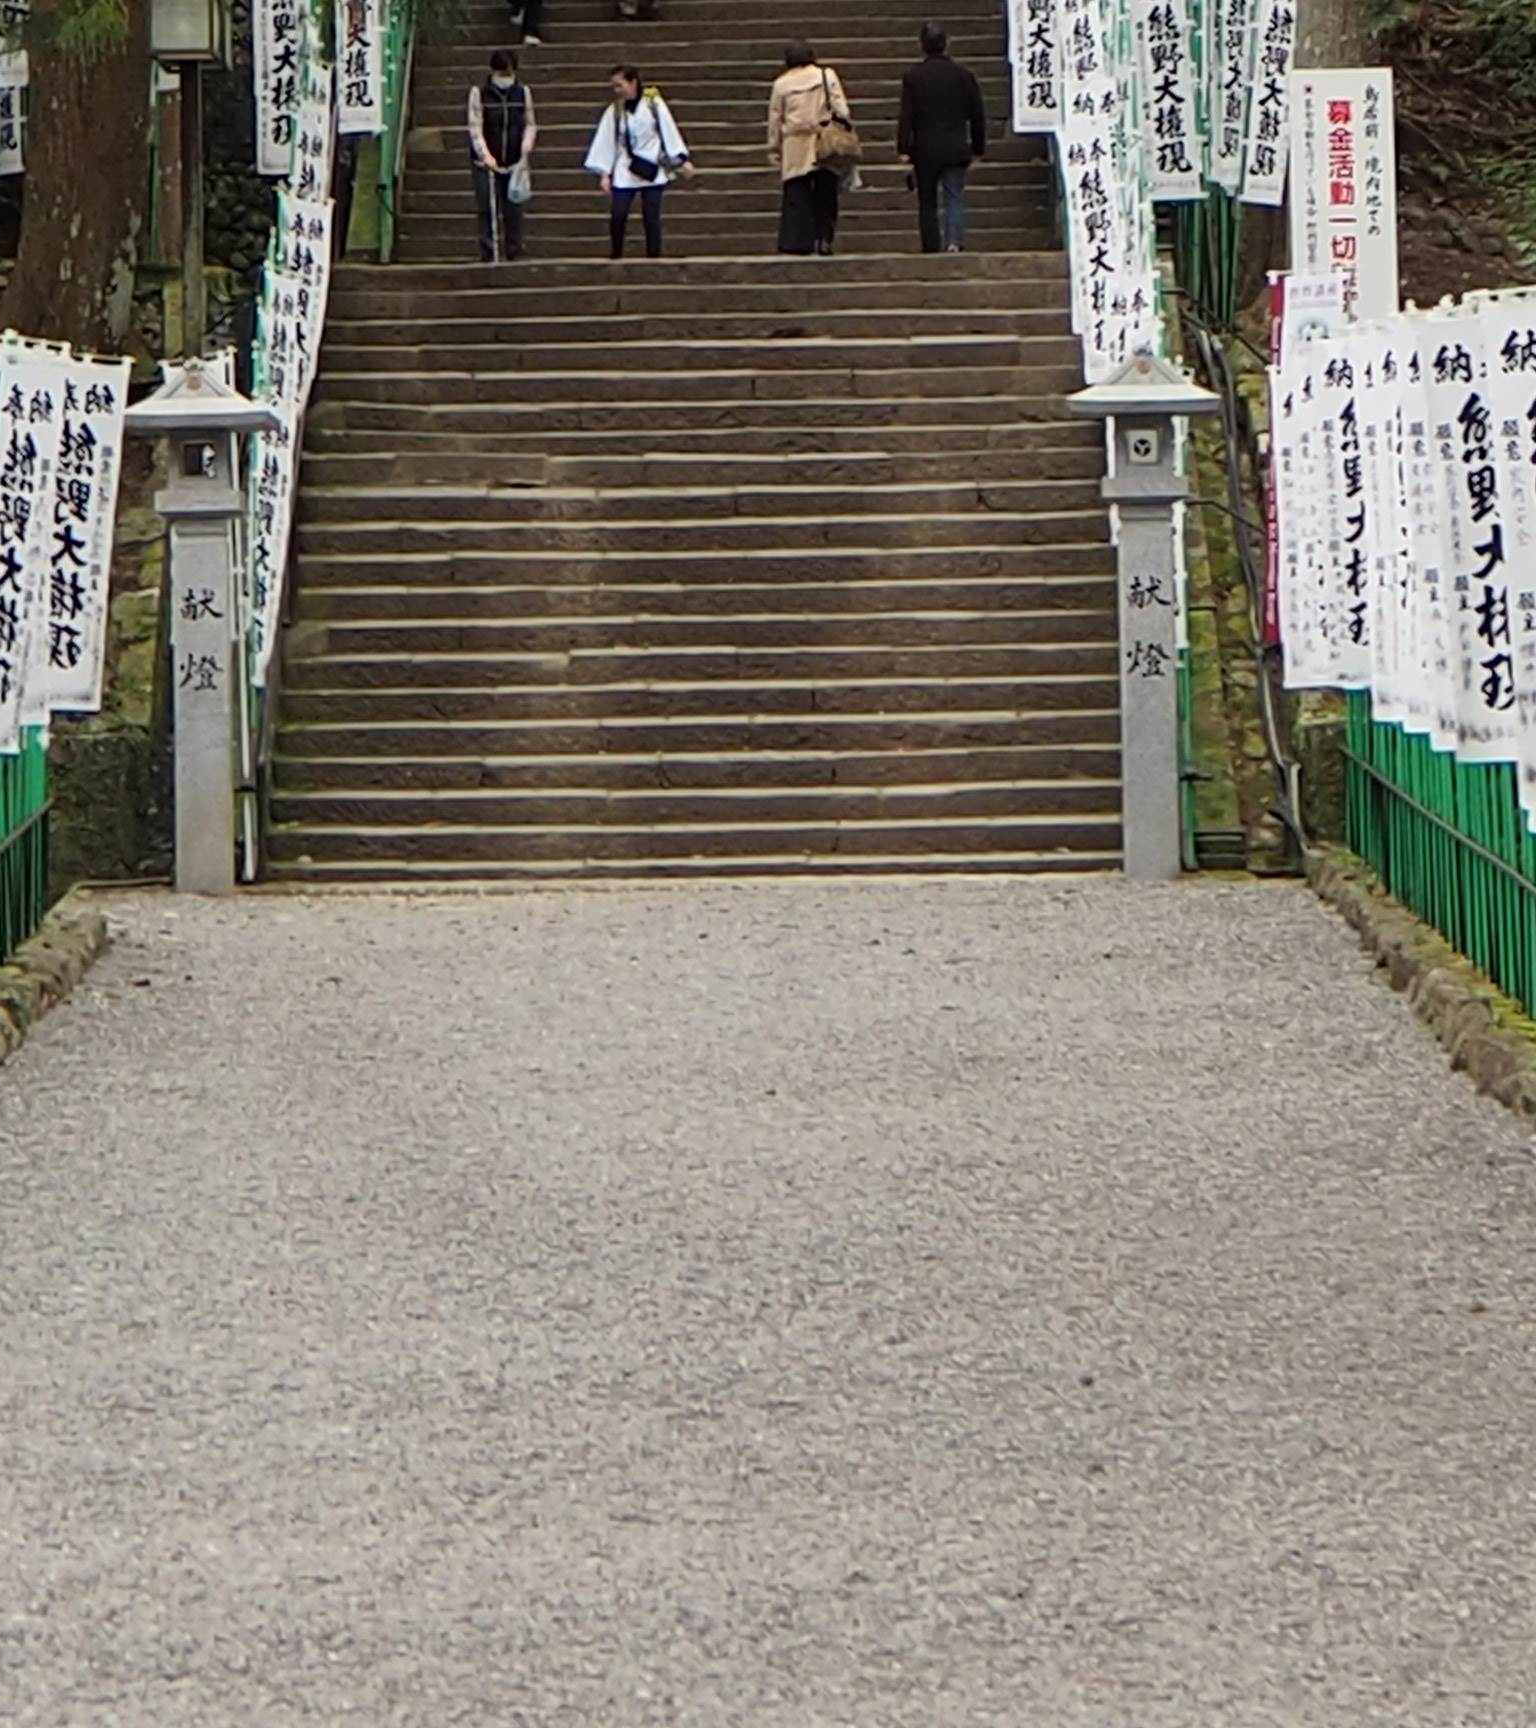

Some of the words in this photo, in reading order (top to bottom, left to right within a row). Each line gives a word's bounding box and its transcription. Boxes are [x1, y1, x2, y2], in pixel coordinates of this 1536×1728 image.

[1148, 2, 1194, 174] 熊野大権現
[1501, 417, 1523, 462] 願意
[179, 587, 224, 692] 献燈
[1126, 576, 1171, 678] 献燈
